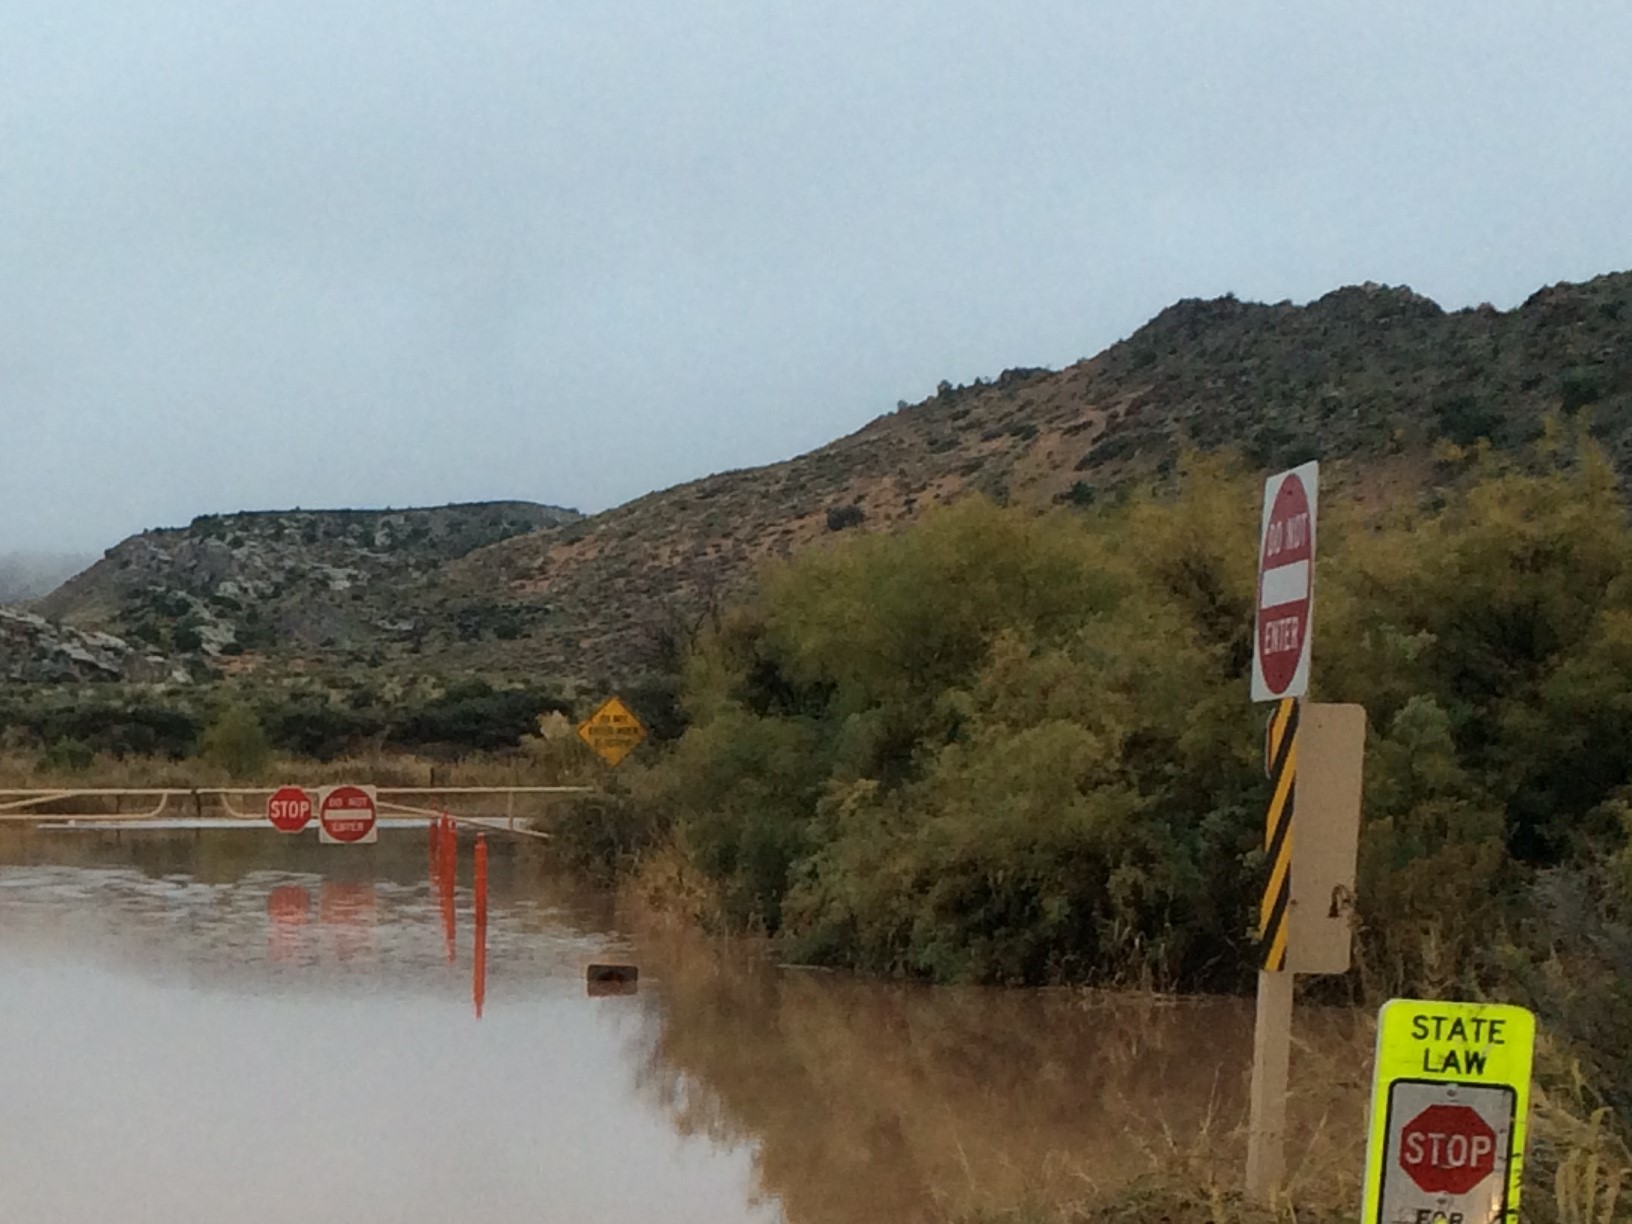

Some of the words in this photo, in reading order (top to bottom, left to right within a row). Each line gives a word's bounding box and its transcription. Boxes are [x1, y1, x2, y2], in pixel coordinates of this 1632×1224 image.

[1264, 616, 1299, 655] ENTER
[270, 800, 310, 819] STOP
[329, 797, 344, 808] DO
[348, 796, 368, 808] NOT
[1411, 1014, 1506, 1045] STATE
[1423, 1047, 1487, 1075] LAW
[1405, 1131, 1492, 1168] STOP
